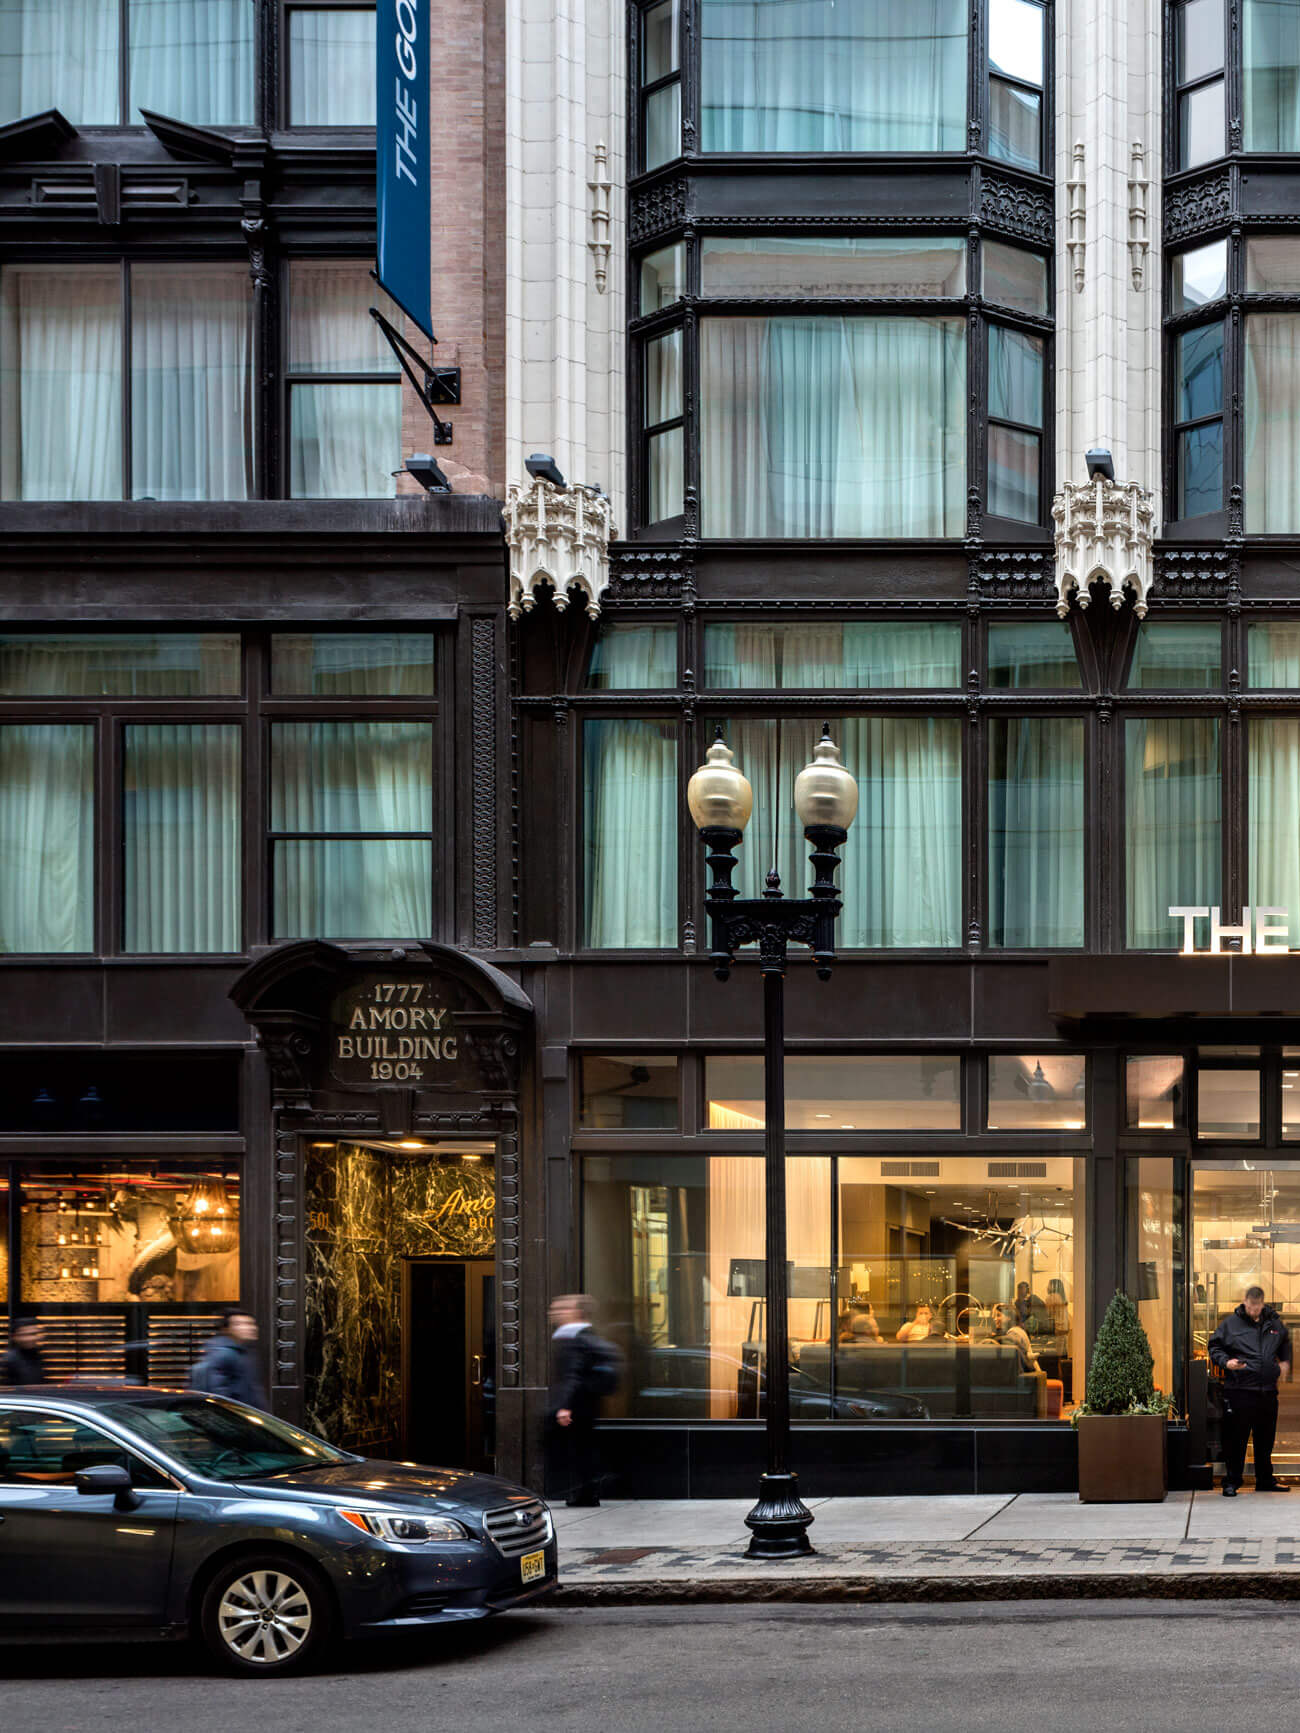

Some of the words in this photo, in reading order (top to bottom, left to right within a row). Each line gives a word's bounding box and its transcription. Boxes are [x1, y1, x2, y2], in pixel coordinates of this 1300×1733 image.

[395, 0, 418, 81] GO
[395, 77, 417, 187] THE
[1168, 905, 1290, 954] THE
[374, 983, 424, 1003] 1777
[349, 1007, 448, 1031] AMORY
[337, 1036, 458, 1060] BUILDING
[370, 1061, 424, 1081] 1904
